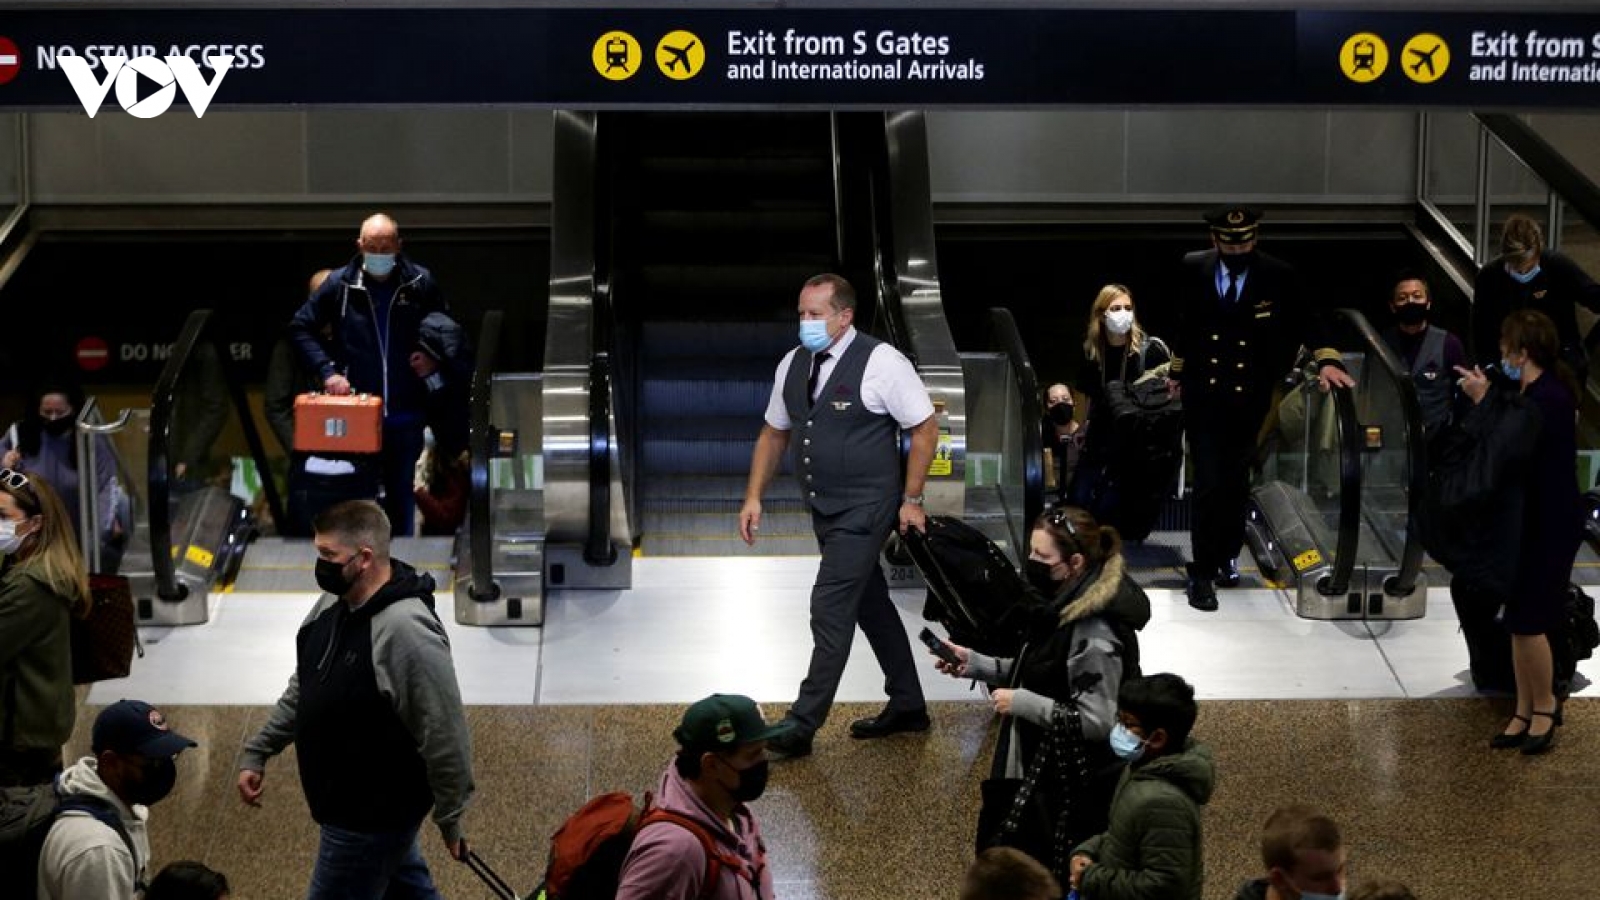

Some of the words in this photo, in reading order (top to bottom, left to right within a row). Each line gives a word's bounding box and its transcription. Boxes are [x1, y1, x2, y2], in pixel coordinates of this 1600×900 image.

[727, 29, 776, 55] Exit
[783, 28, 844, 55] from
[852, 29, 868, 56] S
[876, 29, 950, 55] Gates
[1470, 30, 1519, 58] Exit
[1525, 29, 1585, 58] from
[727, 59, 765, 80] and
[771, 59, 901, 80] International
[908, 59, 984, 80] Arrivals
[1469, 60, 1507, 82] and
[120, 343, 148, 361] DO
[891, 568, 913, 581] 204
